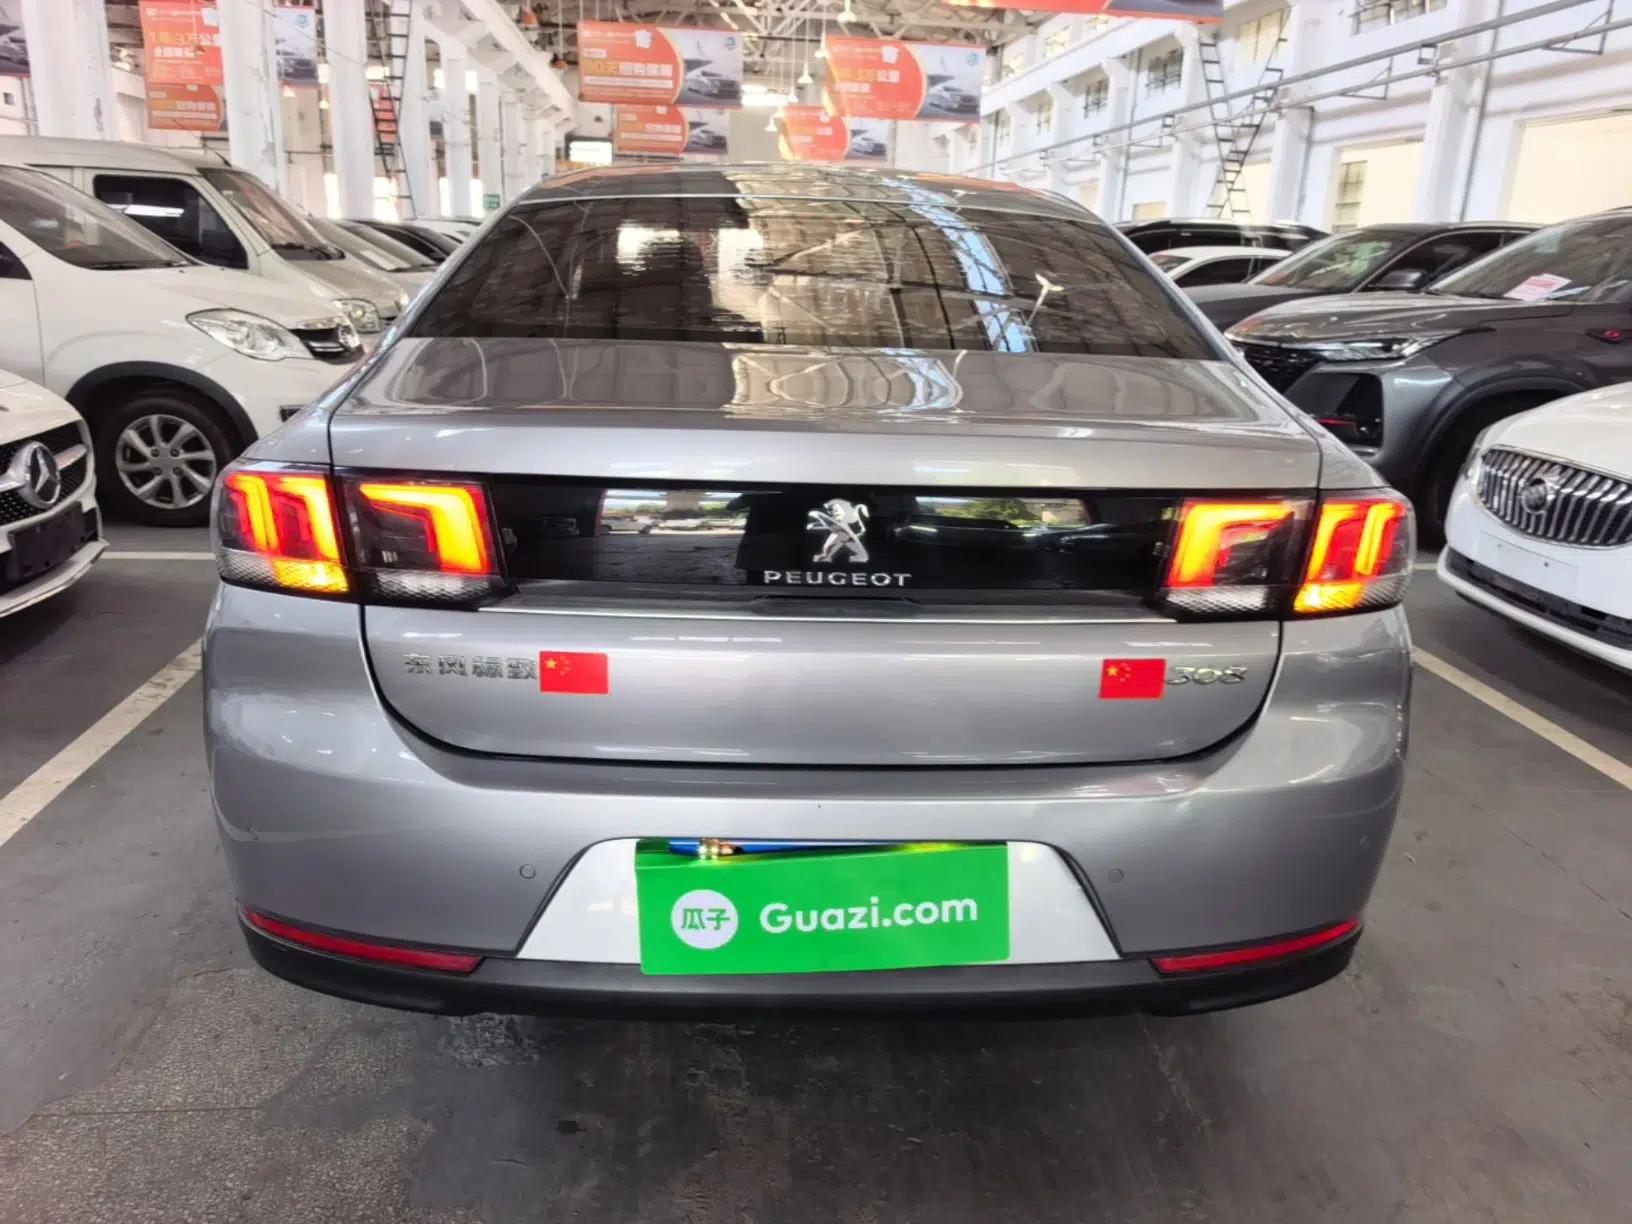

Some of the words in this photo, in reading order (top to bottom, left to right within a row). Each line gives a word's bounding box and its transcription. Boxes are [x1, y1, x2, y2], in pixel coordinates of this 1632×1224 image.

[763, 570, 912, 587] PEUGEOT
[403, 653, 537, 680] 东风标致
[680, 907, 731, 932] 瓜子
[759, 896, 978, 934] Guazi.com
